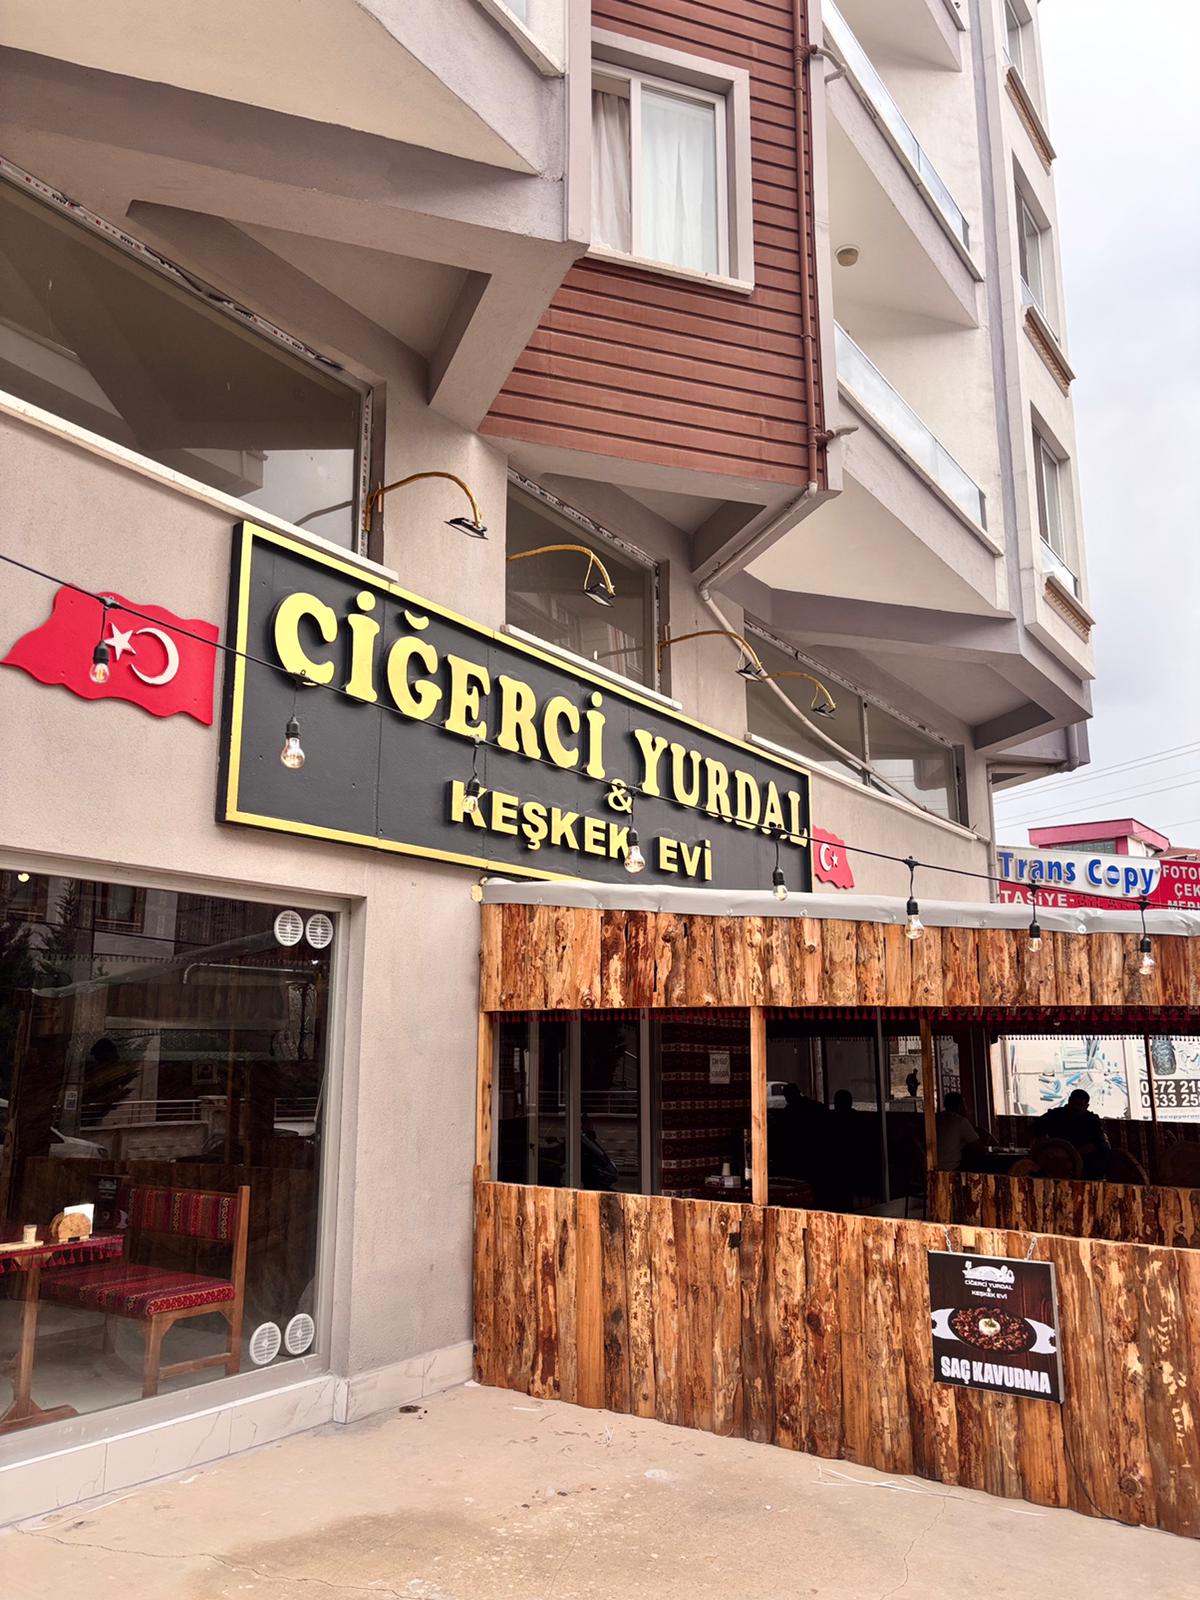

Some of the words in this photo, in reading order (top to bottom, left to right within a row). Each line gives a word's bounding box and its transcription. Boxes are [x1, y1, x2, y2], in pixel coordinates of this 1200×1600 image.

[607, 778, 632, 814] &
[634, 728, 808, 848] YURDAL
[451, 780, 631, 859] KEŞKEK
[659, 836, 712, 881] EVİ
[997, 852, 1076, 882] Trans
[1087, 858, 1154, 896] Copy
[1162, 865, 1200, 880] FOTO
[940, 1356, 971, 1384] SAÇ
[971, 1360, 1052, 1394] KAVURMA
